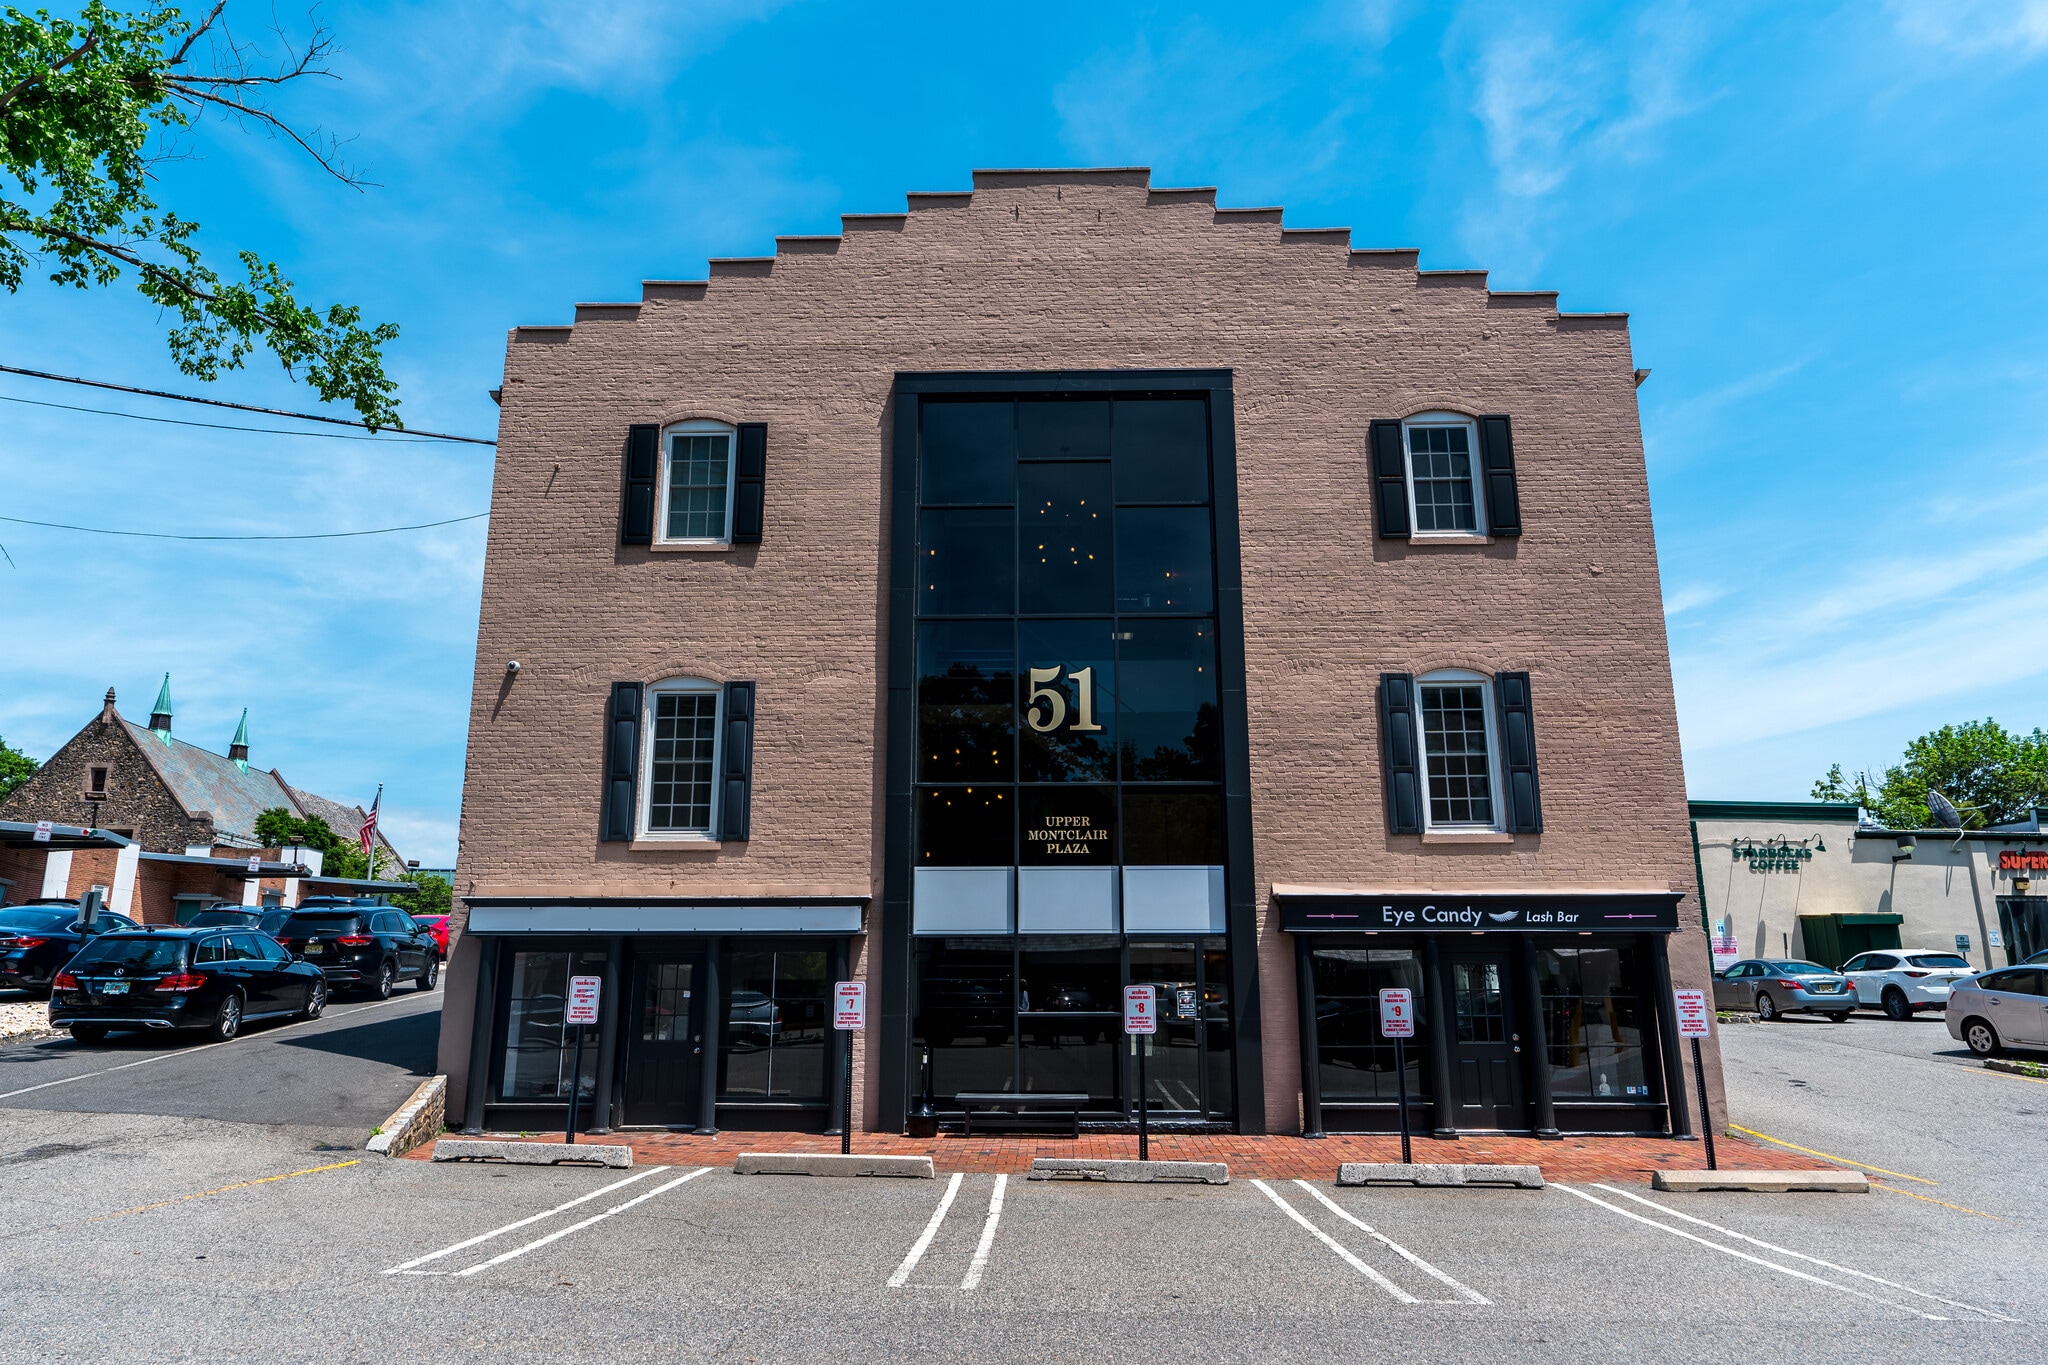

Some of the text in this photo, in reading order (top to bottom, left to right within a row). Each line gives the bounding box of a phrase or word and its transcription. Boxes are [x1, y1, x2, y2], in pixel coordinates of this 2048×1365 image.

[1027, 665, 1102, 733] 51
[1045, 816, 1091, 827] UPPER
[1028, 829, 1108, 841] MONTCLAIR
[1046, 843, 1090, 854] PLAZA
[1749, 860, 1799, 870] COFFEE
[1382, 906, 1482, 927] Eye Candy
[1526, 911, 1579, 923] Lash Bar
